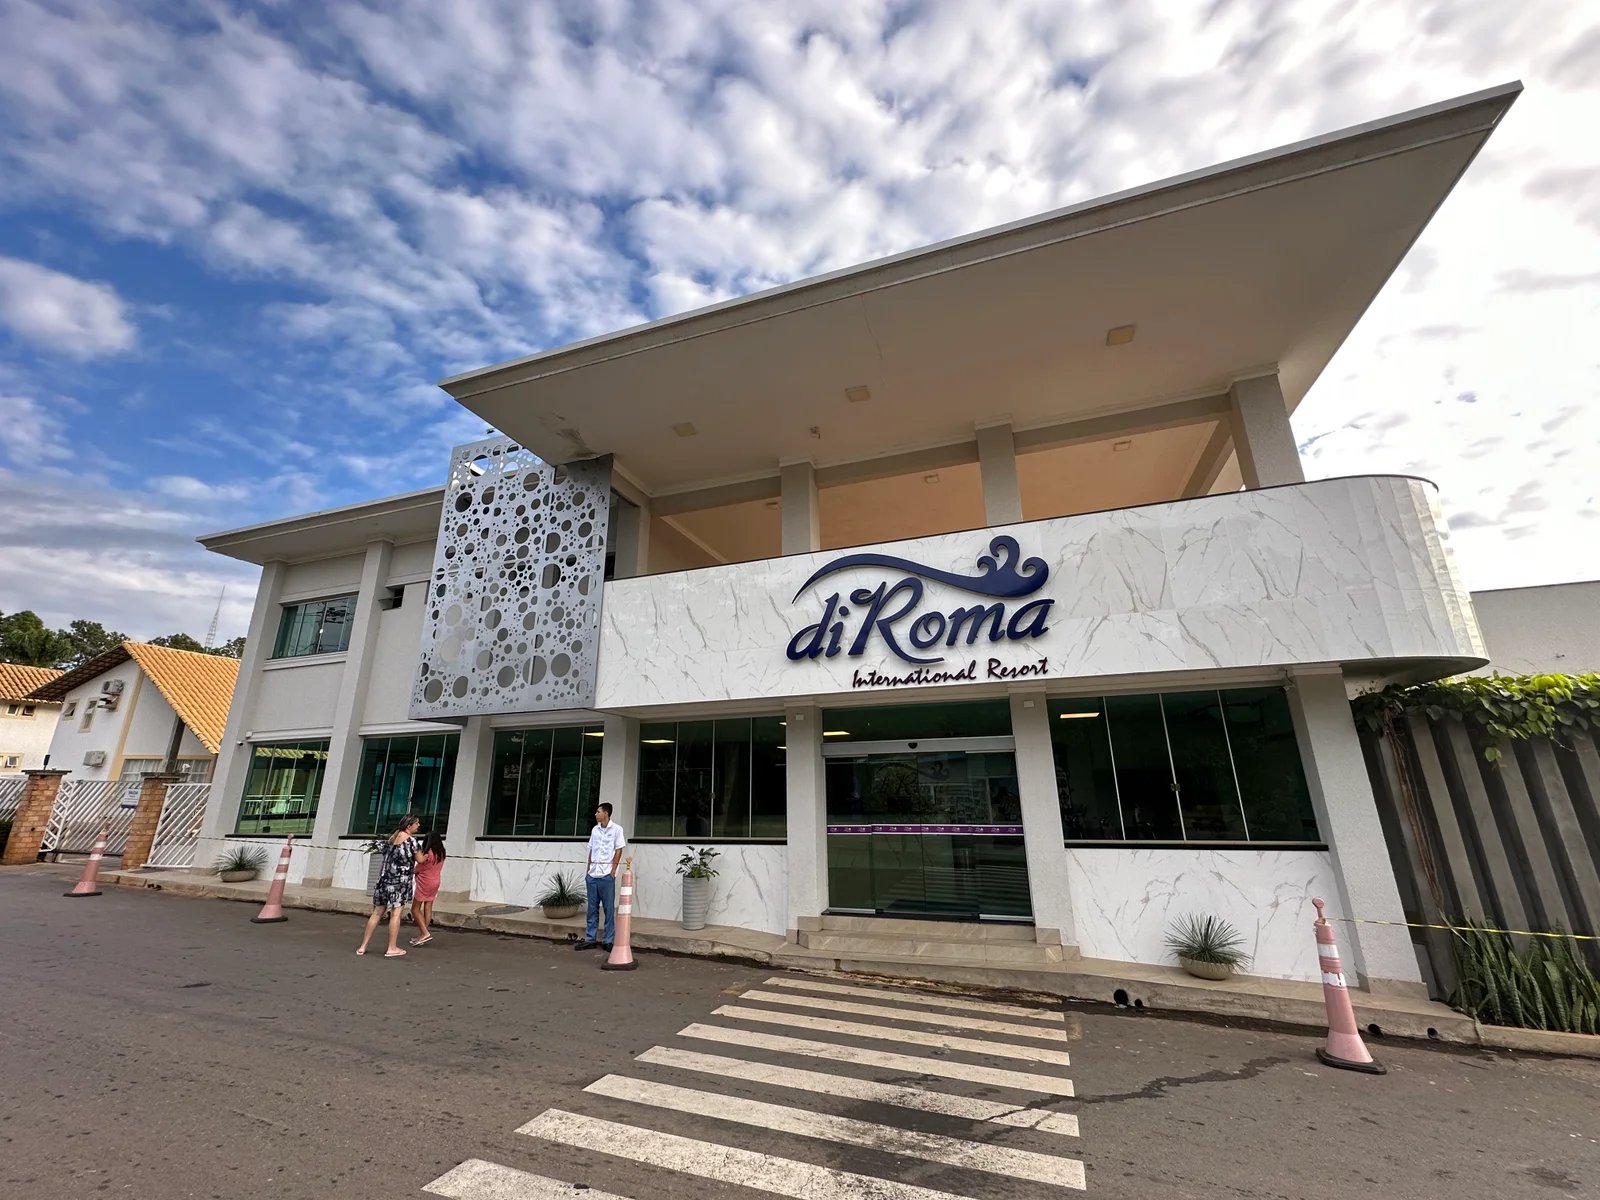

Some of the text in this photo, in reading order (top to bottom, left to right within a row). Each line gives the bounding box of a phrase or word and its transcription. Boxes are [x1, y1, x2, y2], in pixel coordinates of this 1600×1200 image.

[786, 577, 1056, 665] diRoma
[852, 656, 1049, 689] International Resort
